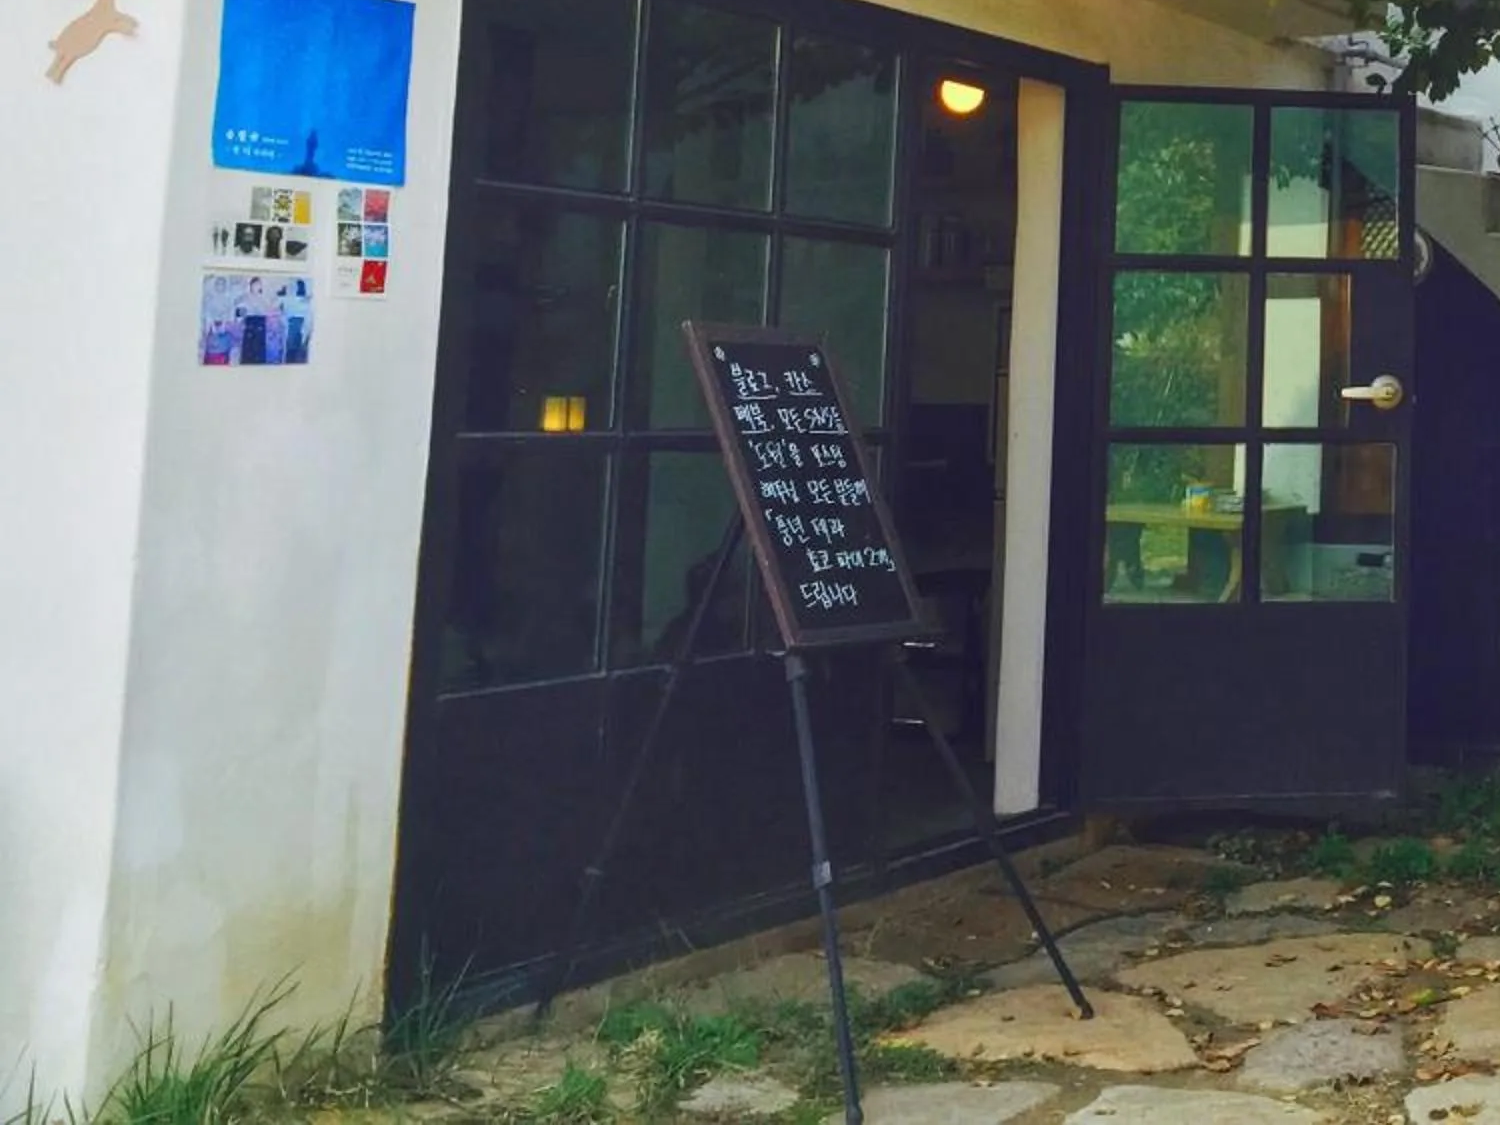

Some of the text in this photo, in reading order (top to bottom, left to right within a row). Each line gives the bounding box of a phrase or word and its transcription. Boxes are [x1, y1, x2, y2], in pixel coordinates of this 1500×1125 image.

[778, 408, 806, 433] 모든
[807, 479, 835, 504] 모든
[800, 580, 857, 609] 드립니다
